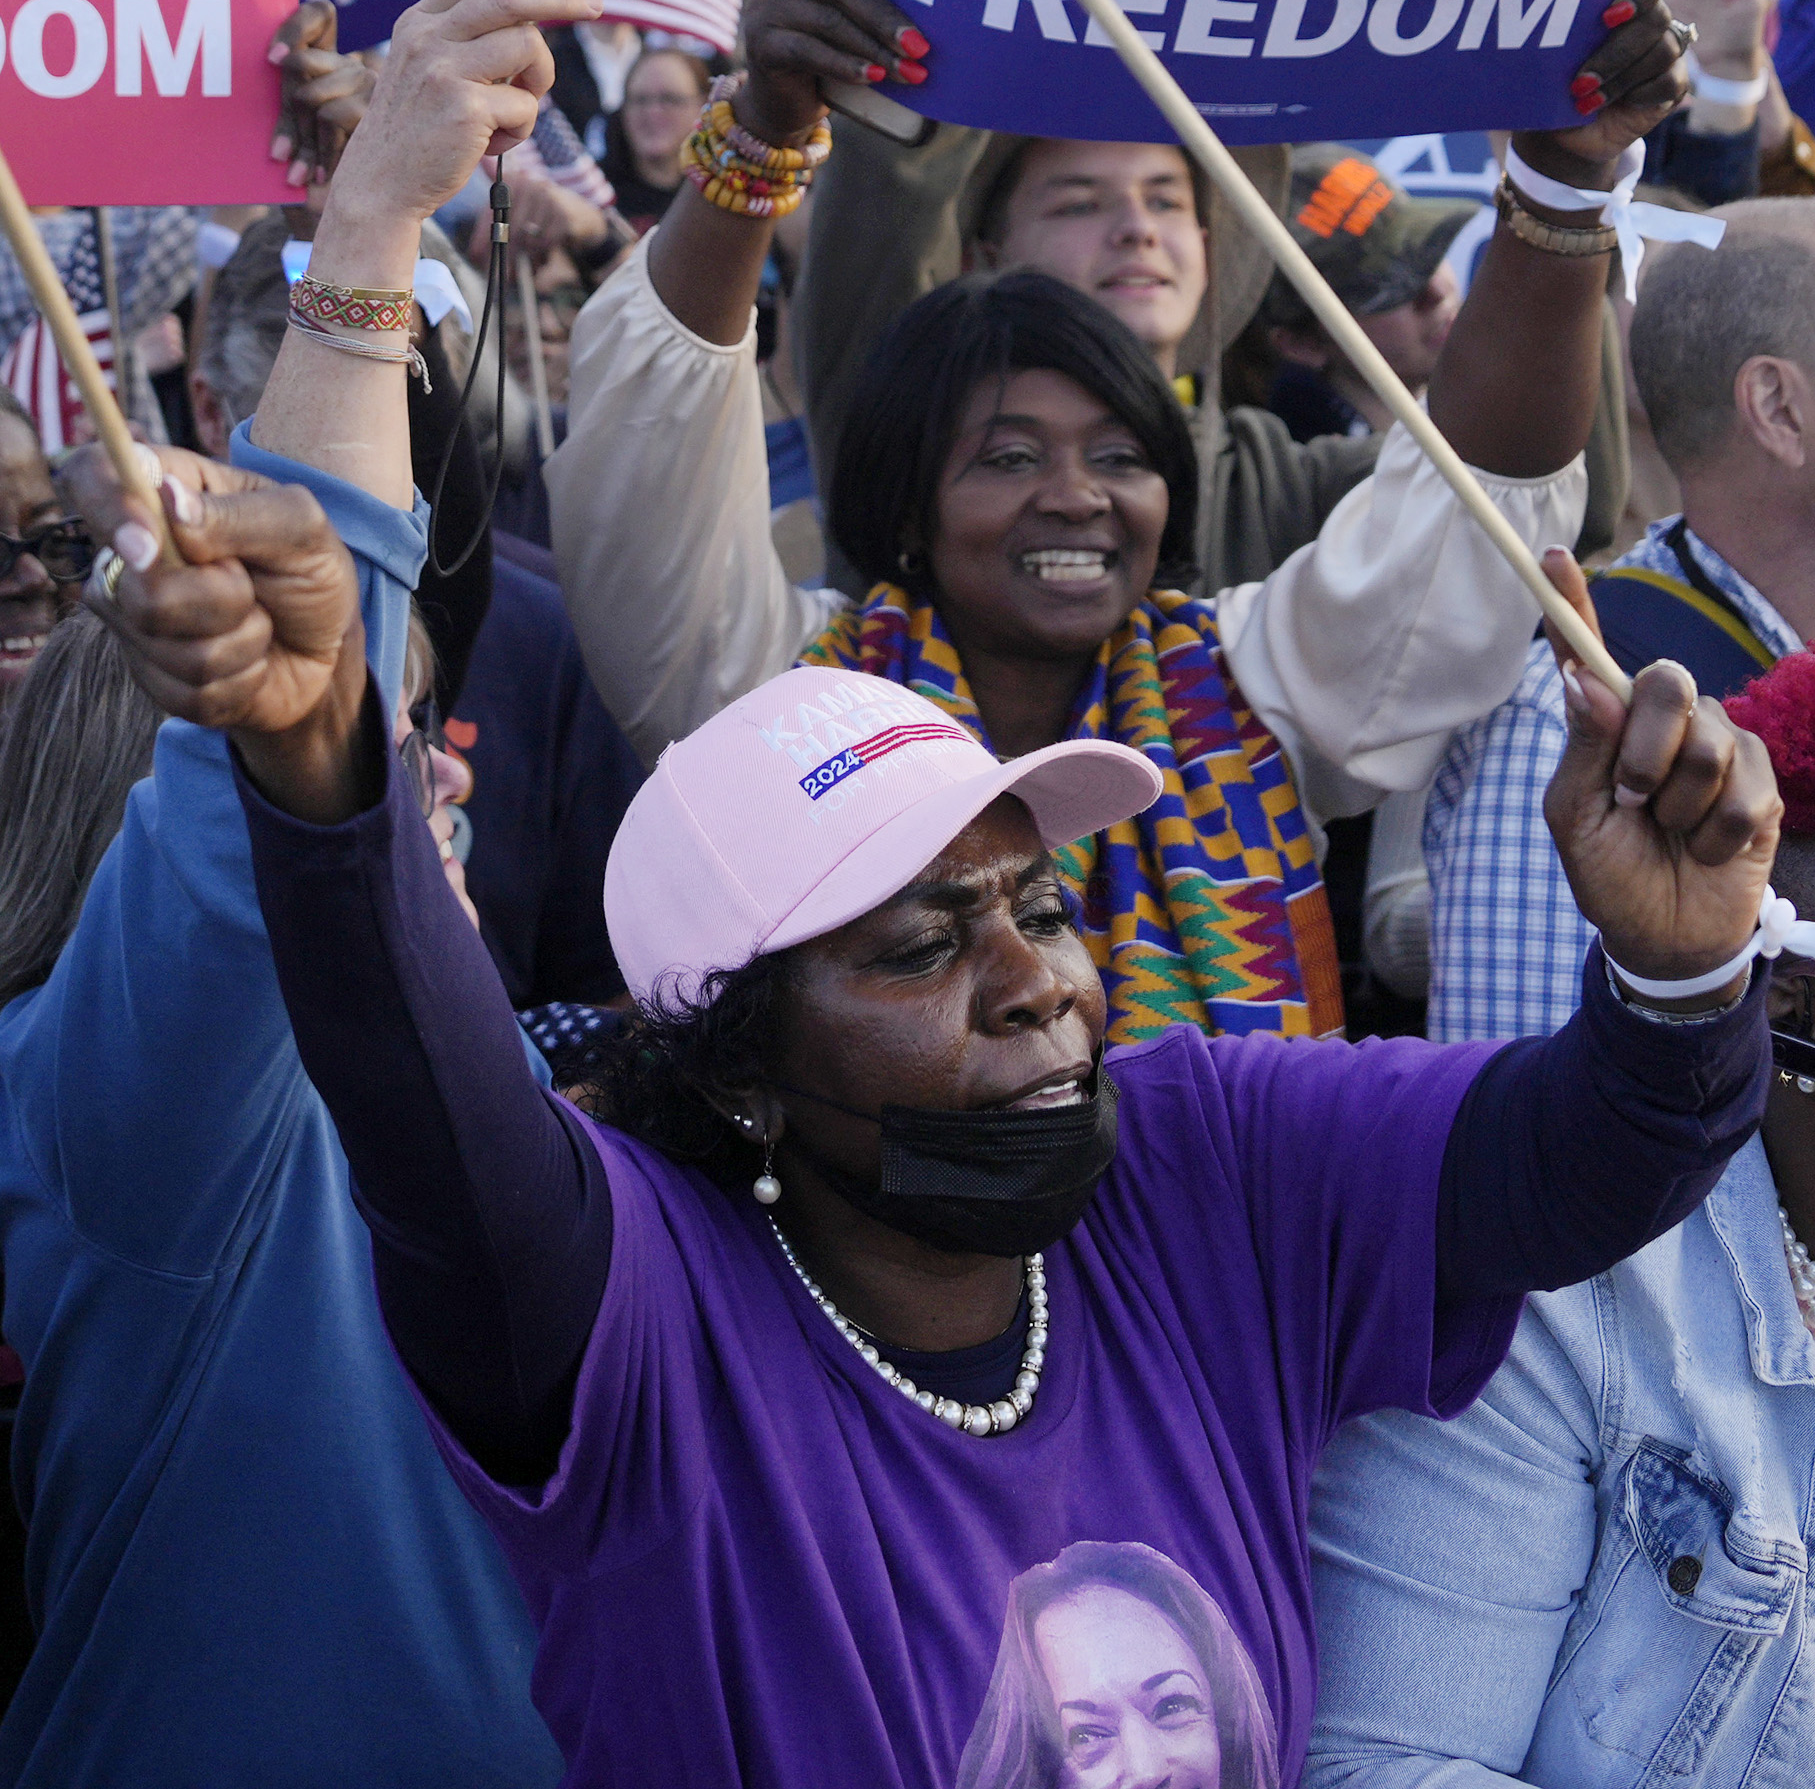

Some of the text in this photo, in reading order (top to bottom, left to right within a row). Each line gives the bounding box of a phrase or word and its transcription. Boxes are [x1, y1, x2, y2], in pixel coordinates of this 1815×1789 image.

[759, 680, 912, 752] KAMAL
[803, 749, 861, 797] 2024
[807, 776, 866, 826] FOR
